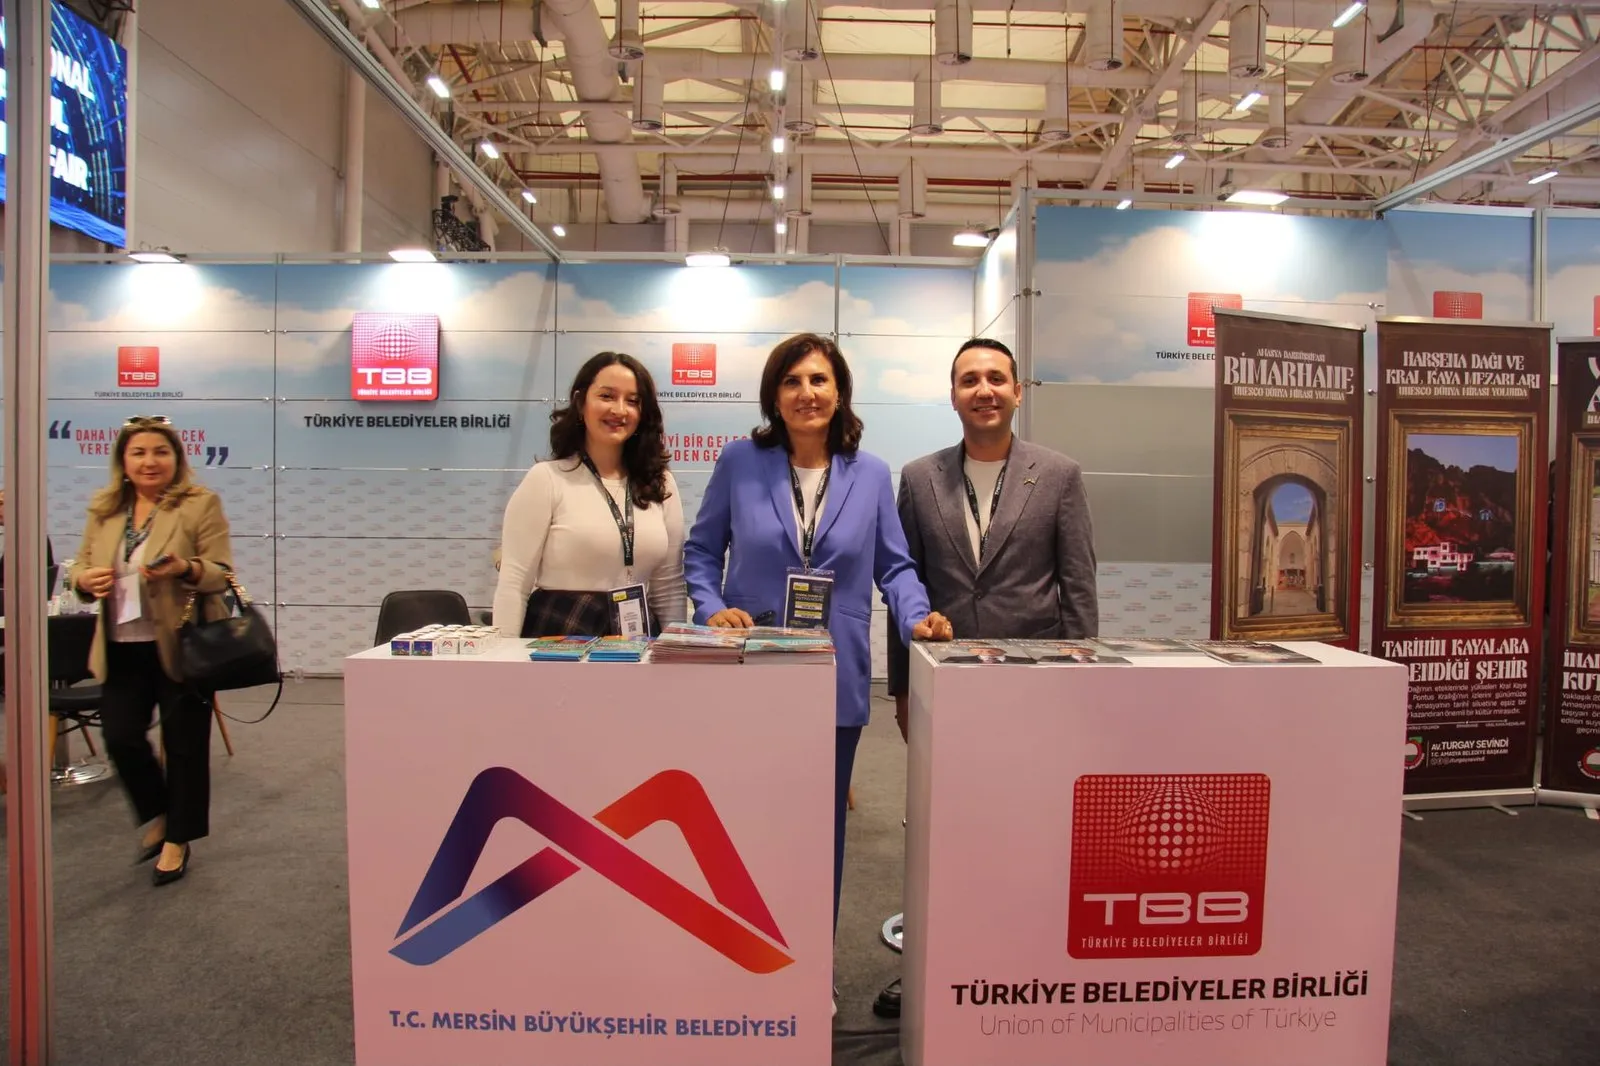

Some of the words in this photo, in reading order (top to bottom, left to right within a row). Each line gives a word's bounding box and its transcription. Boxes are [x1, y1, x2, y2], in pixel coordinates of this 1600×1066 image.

[1156, 350, 1190, 360] TÜRKİYE
[1471, 352, 1502, 370] DAĞI
[1506, 355, 1525, 371] VE
[120, 371, 157, 381] TBB
[357, 368, 432, 385] TBB
[674, 369, 713, 379] TBB
[1385, 369, 1423, 385] KRAL
[1427, 370, 1461, 385] KAYA
[304, 413, 364, 428] TÜRKİYE
[366, 413, 458, 428] BELEDİYELER
[461, 413, 510, 429] BİRLİĞİ
[75, 429, 105, 441] DAHA
[683, 432, 703, 448] BİR
[1451, 637, 1530, 656] KAYALARA
[1408, 658, 1470, 682] ENDİĞİ
[1475, 656, 1528, 684] ŞEHİR
[1441, 740, 1477, 751] TURGAY
[1476, 737, 1509, 749] SEVİNDİ
[1083, 891, 1250, 926] TBB
[1081, 935, 1127, 948] TÜRKİYE
[1132, 934, 1203, 948] BELEDİYELER
[1208, 932, 1249, 946] BİRLİĞİ
[951, 978, 1076, 1005] TÜRKİYE
[1083, 975, 1266, 1004] BELEDİYELER
[1272, 970, 1369, 999] BİRLİĞİ
[389, 1009, 426, 1029] T.C.
[432, 1008, 516, 1032] MERSİN
[524, 1011, 668, 1040] BÜYÜKŞEHİR
[675, 1014, 797, 1037] BELEDİYESİ
[980, 1013, 1045, 1036] Union
[1051, 1011, 1076, 1034] of
[1081, 1009, 1225, 1038] Municipalities
[1231, 1008, 1257, 1031] of
[1263, 1006, 1337, 1032] Türkiye
